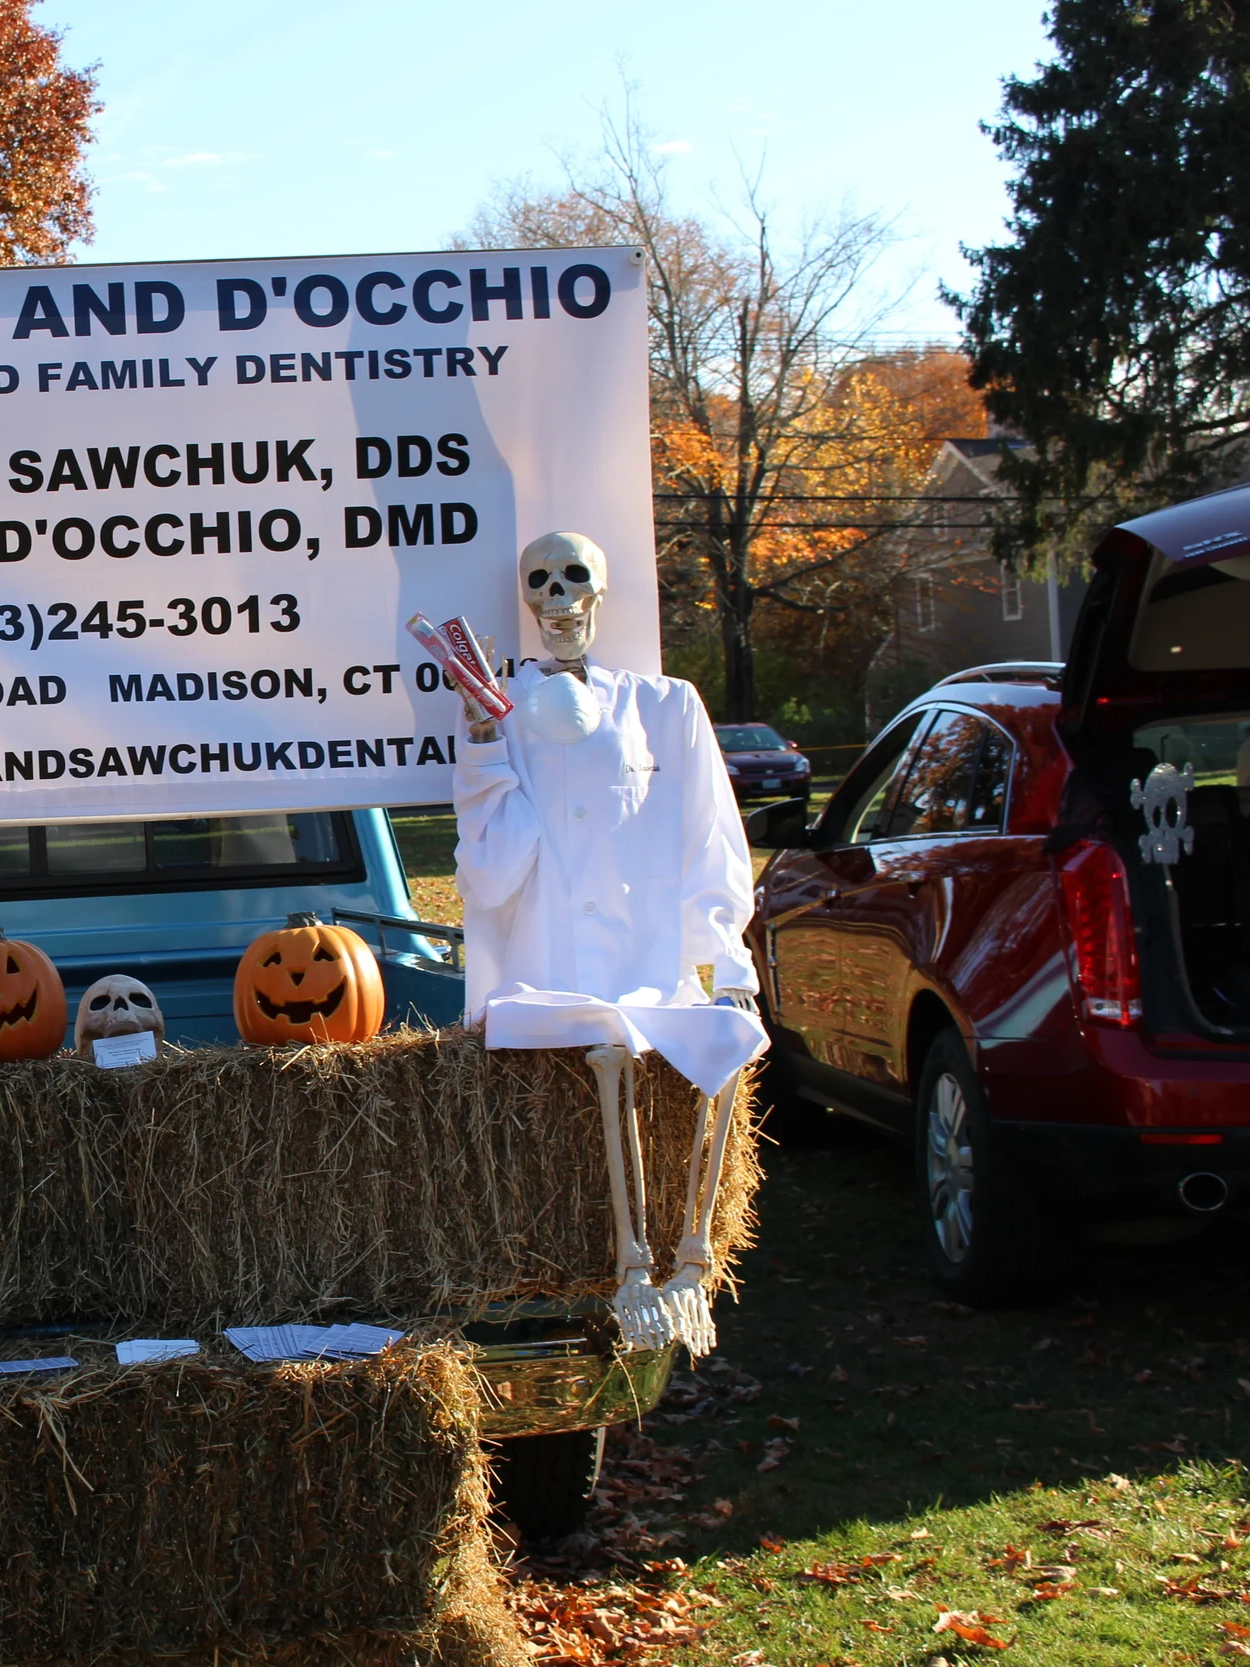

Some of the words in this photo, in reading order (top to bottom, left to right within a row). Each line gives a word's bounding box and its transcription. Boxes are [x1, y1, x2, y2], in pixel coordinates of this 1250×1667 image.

[12, 281, 185, 340] AND
[216, 263, 611, 332] D'OCCHIO
[38, 356, 218, 393] FAMILY
[236, 345, 509, 385] DENTISTRY
[8, 438, 333, 494] SAWCHUK,
[355, 433, 470, 480] DDS
[344, 502, 478, 549] DMD
[108, 667, 327, 705] MADISON,
[343, 664, 401, 696] CT
